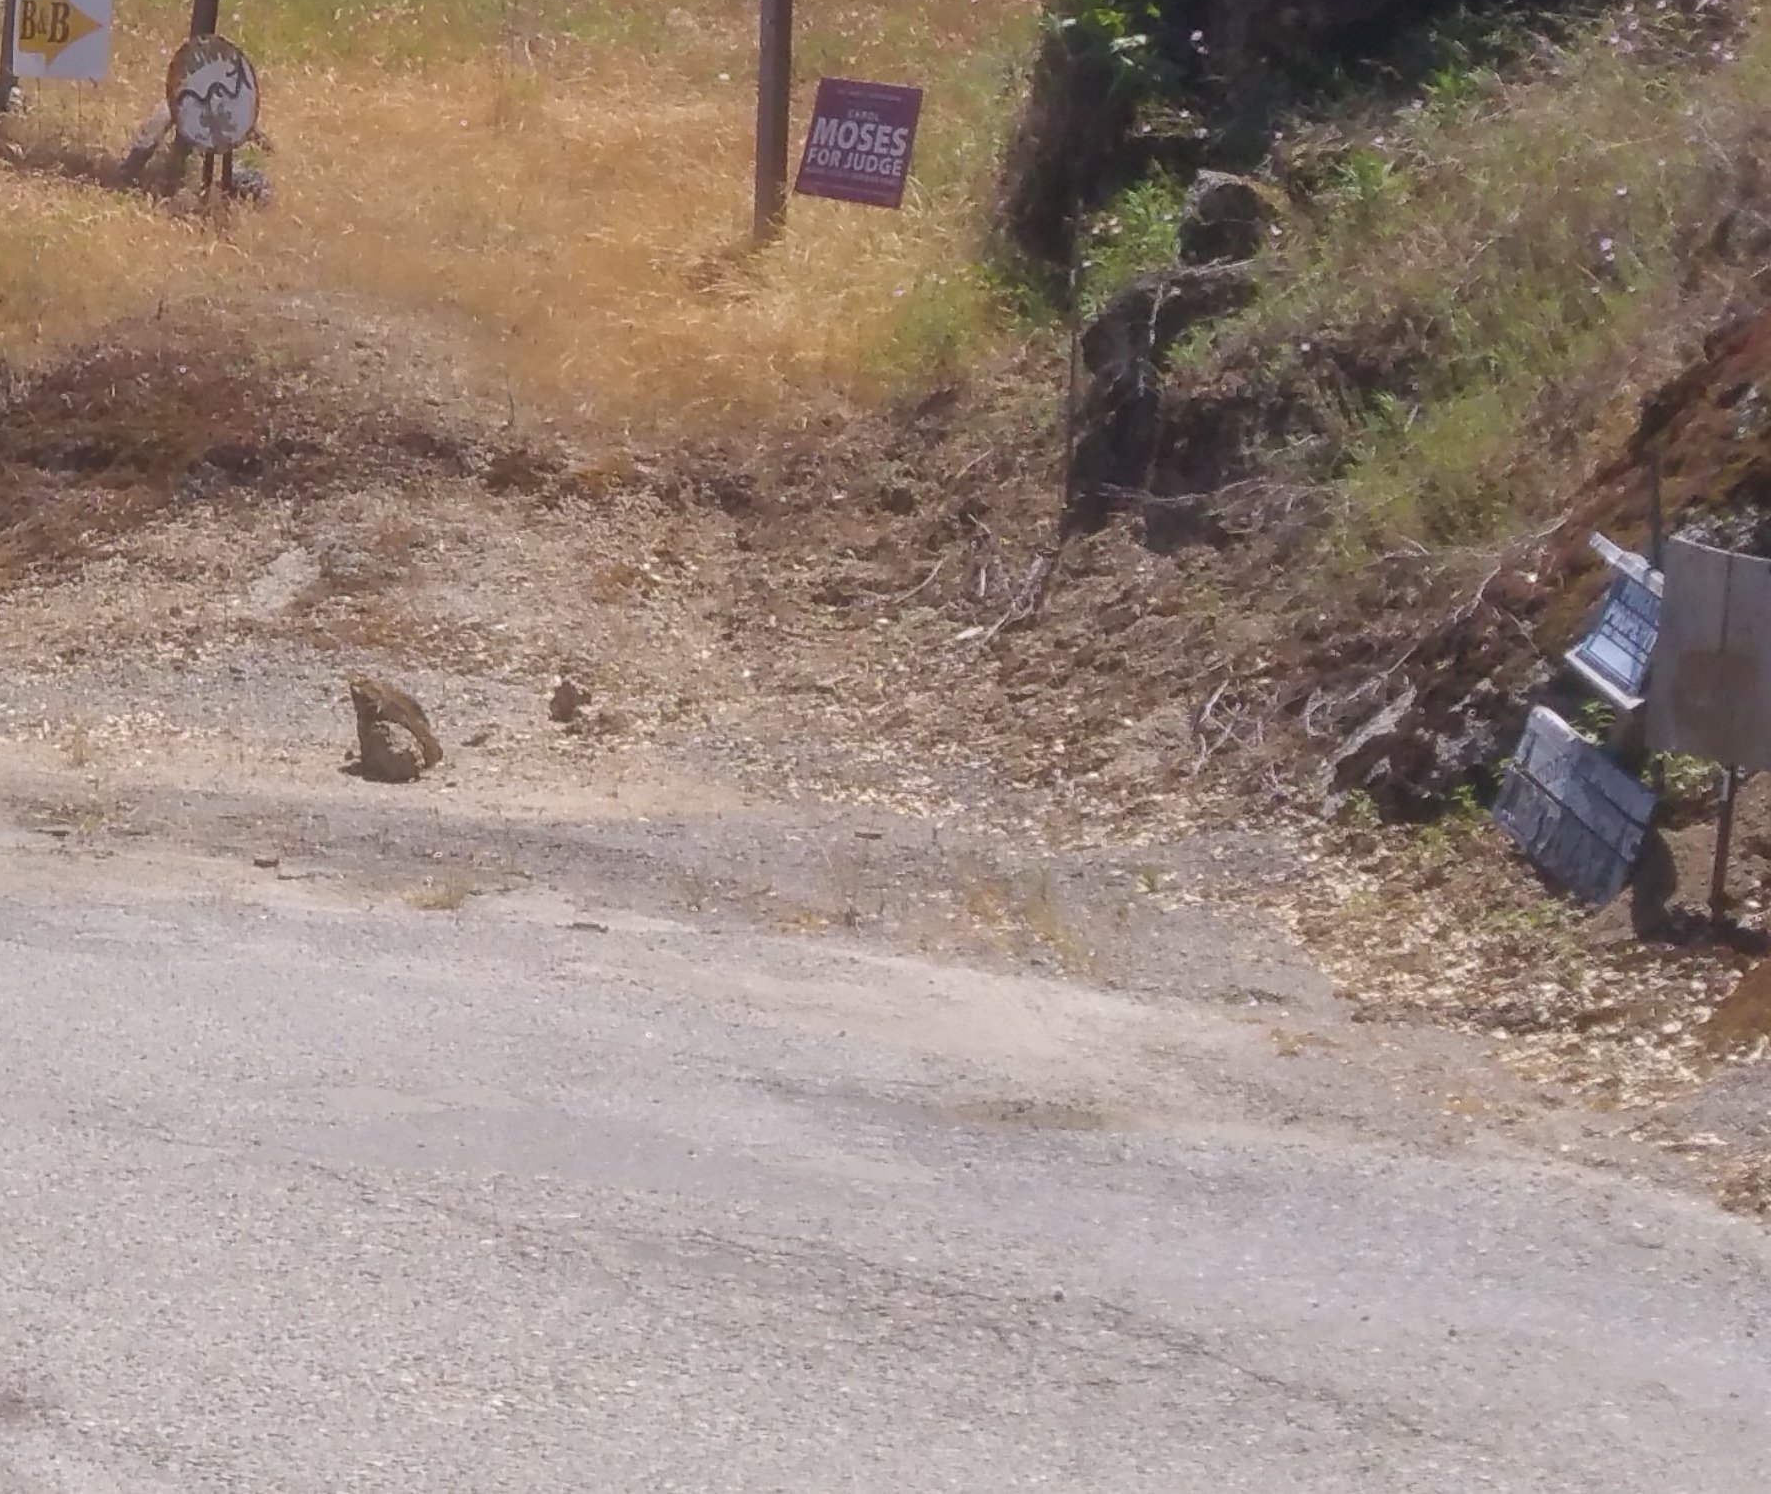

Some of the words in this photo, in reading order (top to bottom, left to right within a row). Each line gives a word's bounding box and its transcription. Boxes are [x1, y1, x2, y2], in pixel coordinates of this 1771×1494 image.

[812, 116, 910, 157] MOSES
[806, 147, 842, 168] FOR
[843, 152, 904, 177] JUDGE
